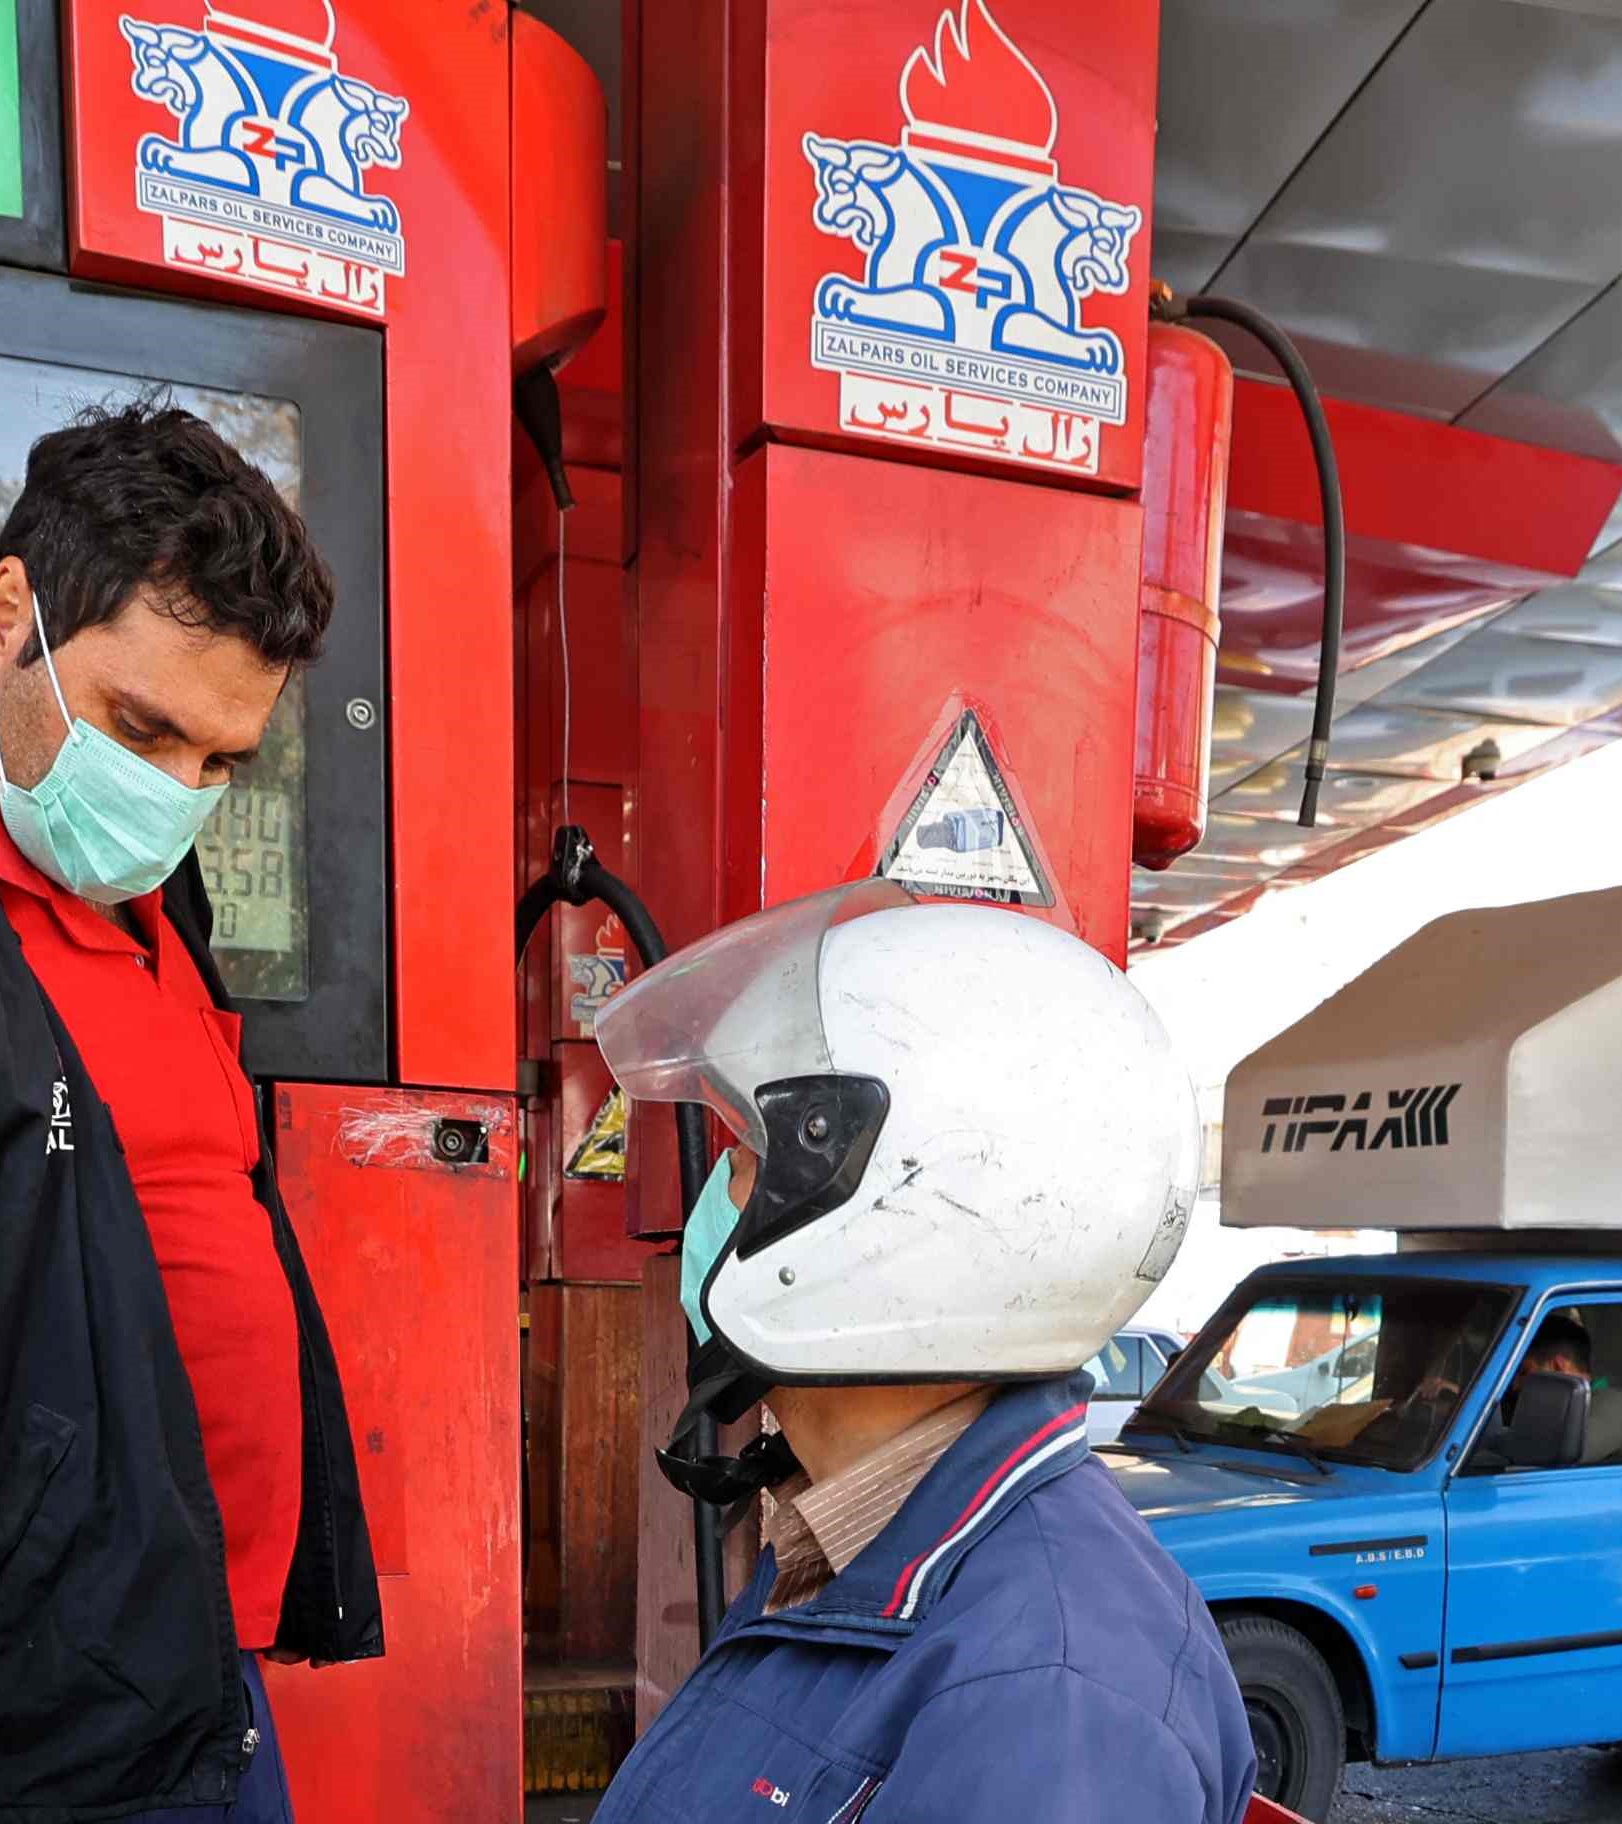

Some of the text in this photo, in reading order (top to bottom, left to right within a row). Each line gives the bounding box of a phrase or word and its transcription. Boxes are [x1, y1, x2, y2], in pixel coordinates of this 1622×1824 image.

[149, 184, 394, 258] ZALPARS OIL SERVICES COMPANY
[827, 335, 1111, 406] ZALPARS OIL SERVICES COMPANY
[1261, 1083, 1463, 1153] TIPAX
